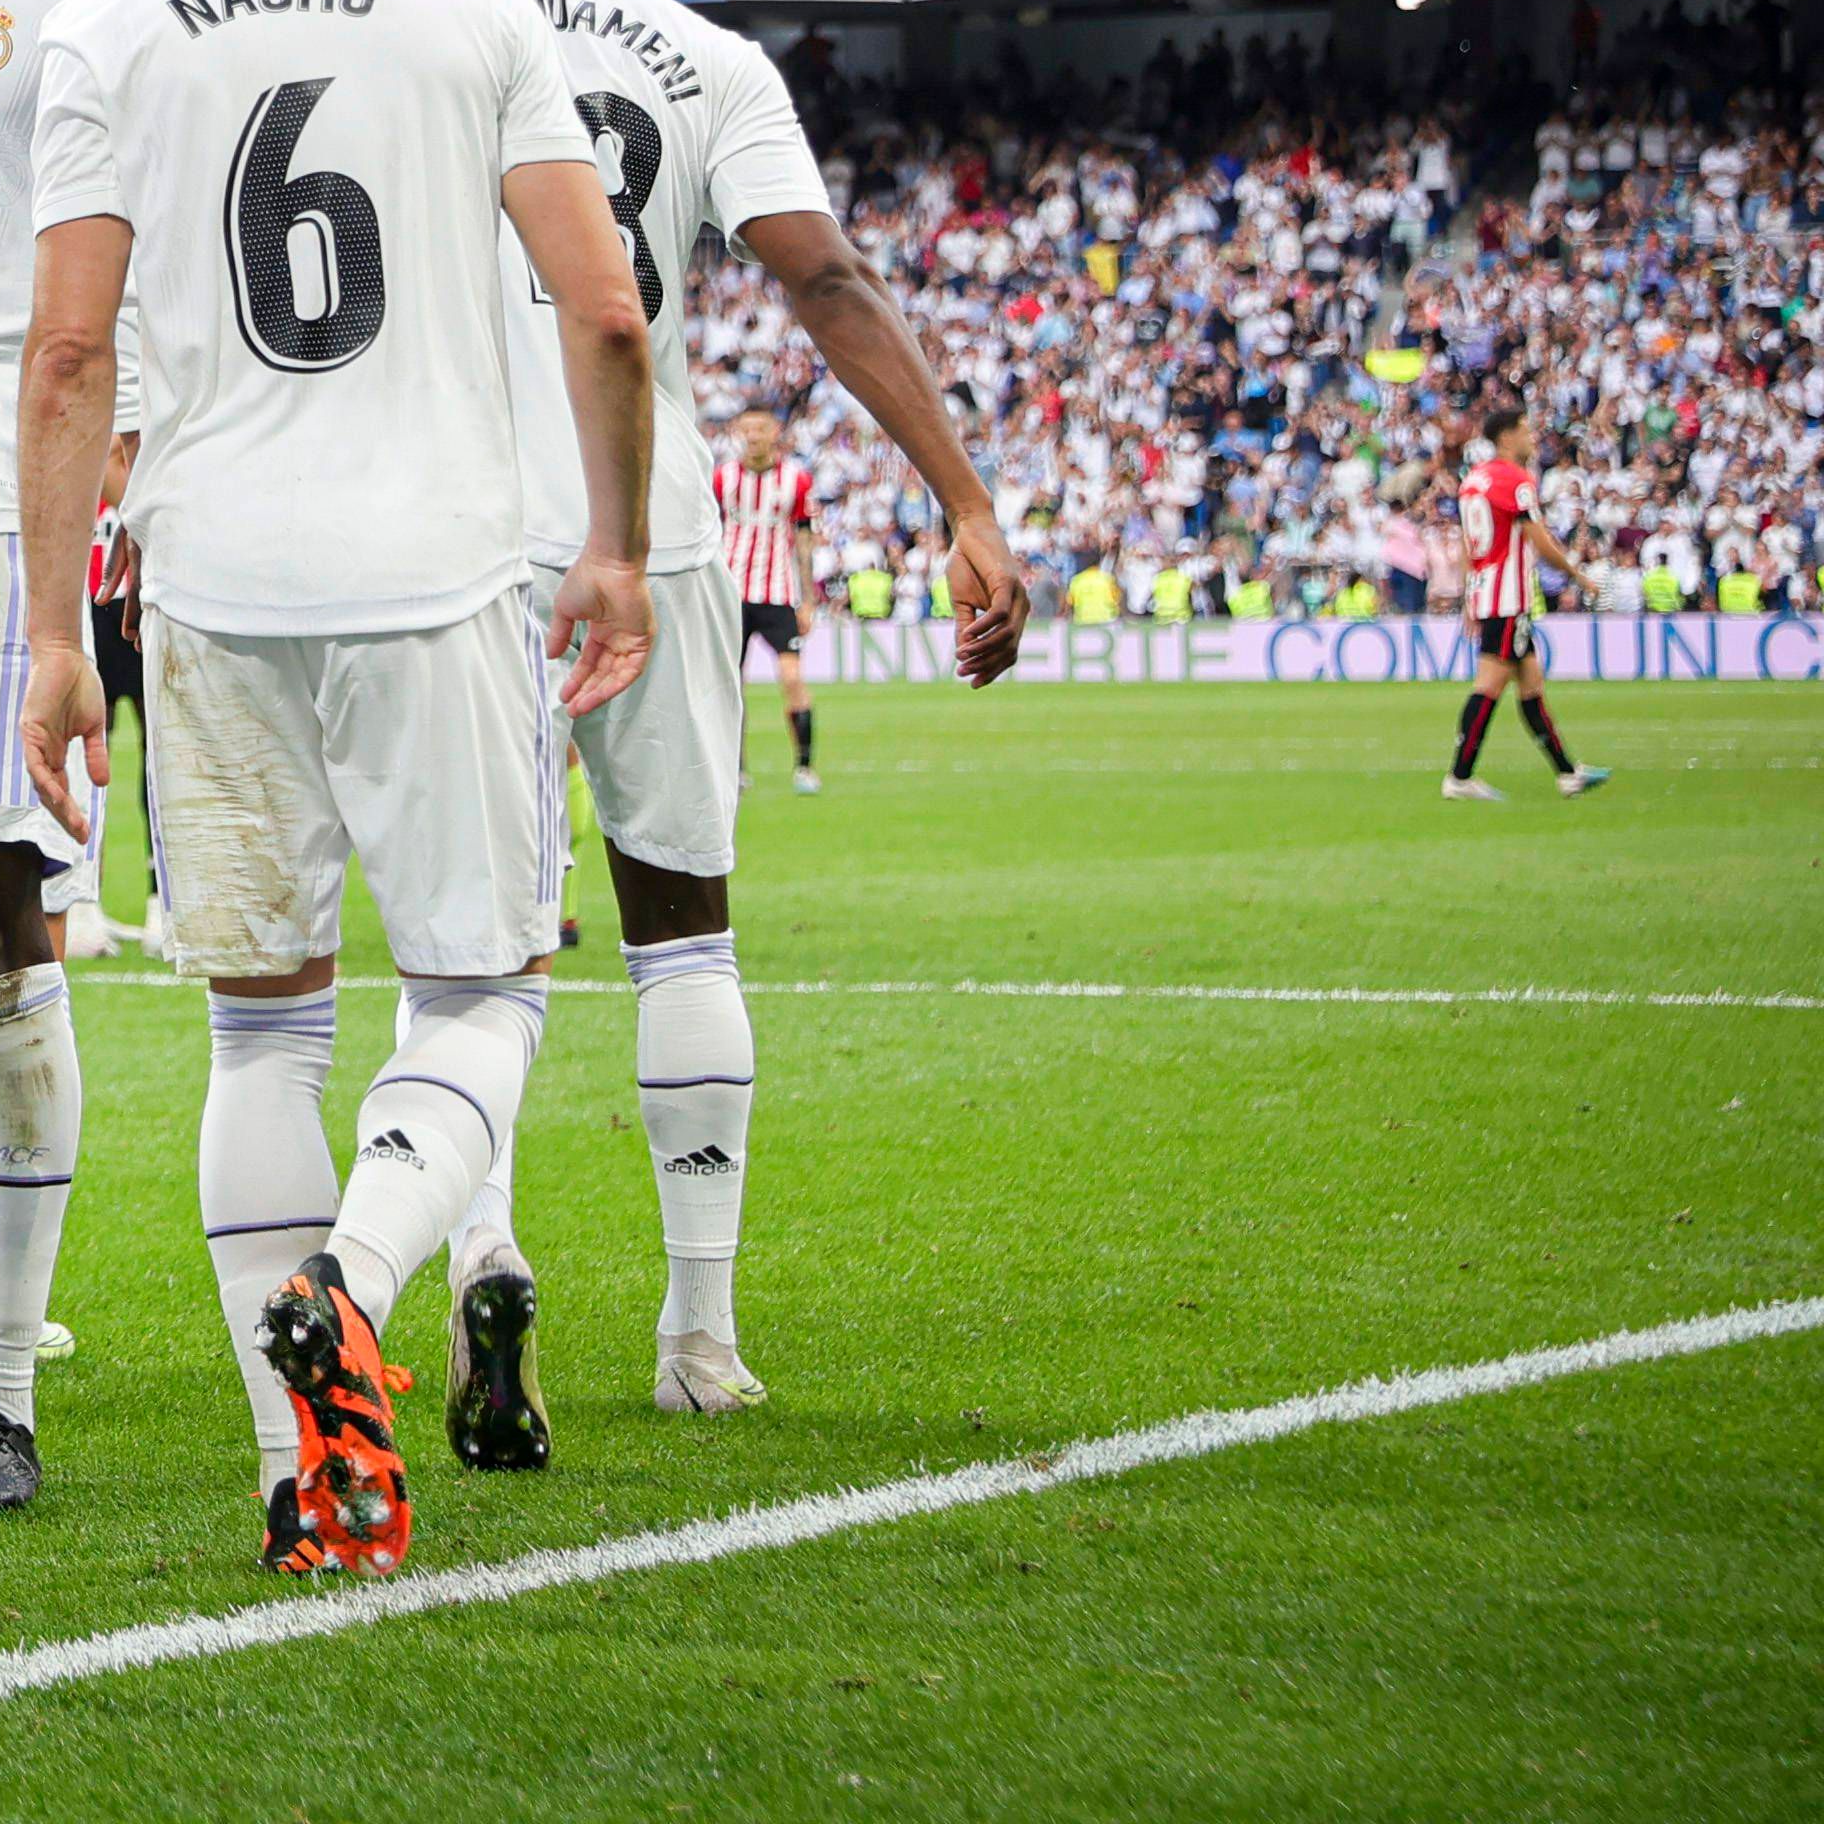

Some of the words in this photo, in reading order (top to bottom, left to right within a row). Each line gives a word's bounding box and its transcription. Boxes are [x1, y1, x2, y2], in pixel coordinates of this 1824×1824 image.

[223, 76, 386, 375] 6
[1265, 620, 1552, 682] COM
[1588, 616, 1718, 678] UN
[665, 1160, 739, 1176] adidas
